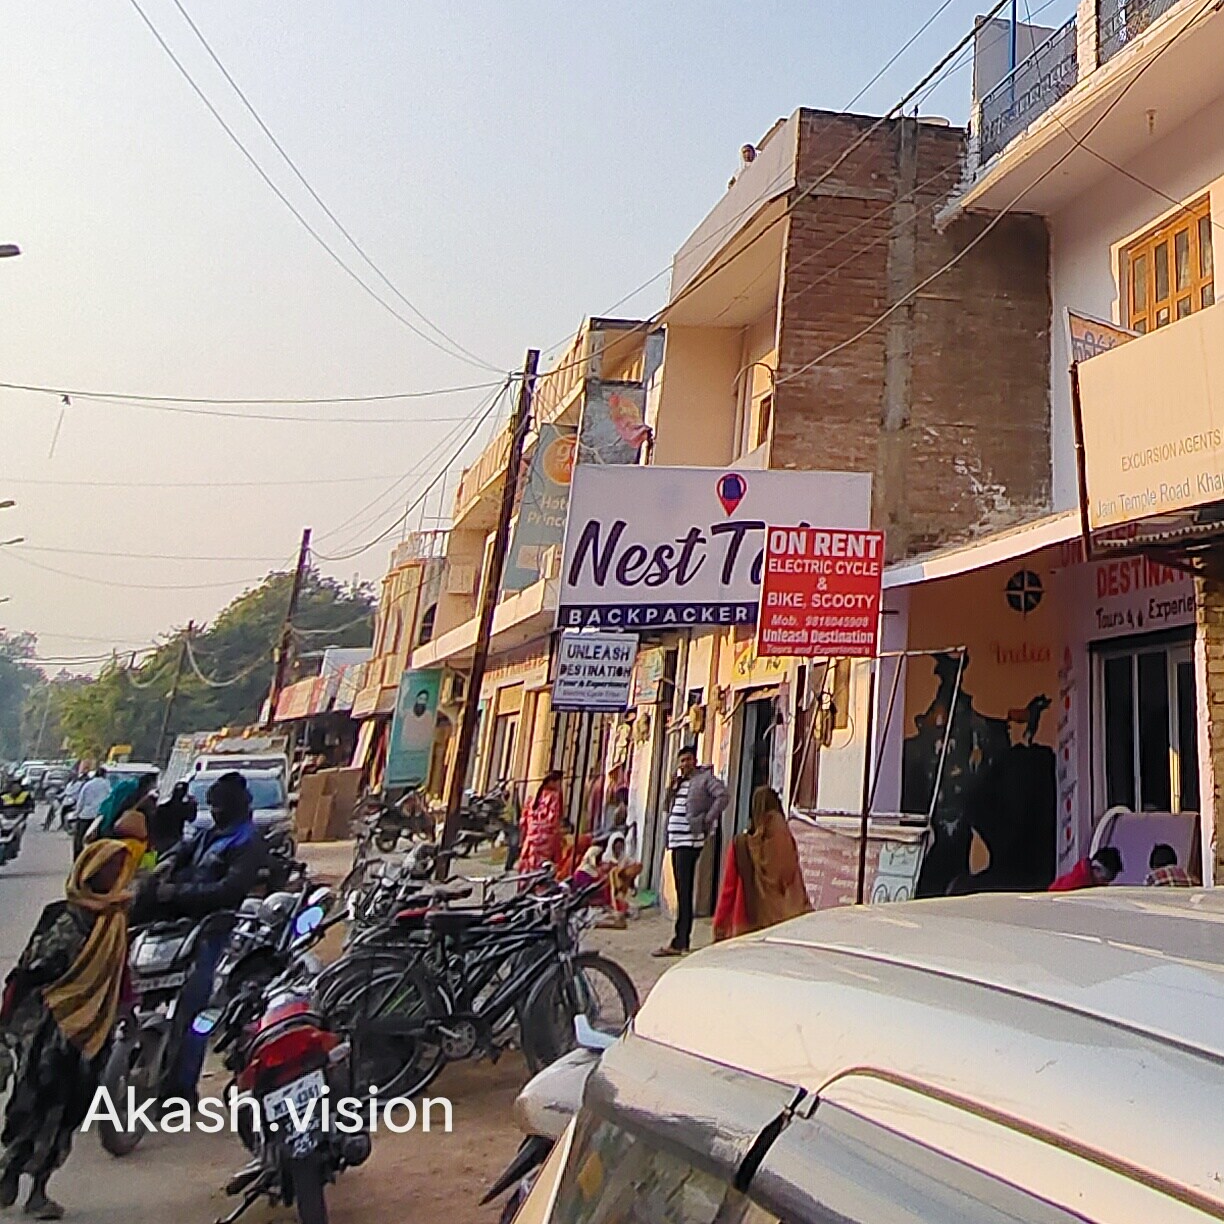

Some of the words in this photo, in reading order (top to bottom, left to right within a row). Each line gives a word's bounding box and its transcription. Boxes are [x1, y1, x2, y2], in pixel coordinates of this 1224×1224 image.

[1121, 443, 1177, 472] EXCURSION
[1178, 429, 1222, 456] AGENTS
[1118, 487, 1157, 513] Temple
[567, 520, 707, 587] Nest
[769, 530, 807, 555] ON
[813, 532, 881, 559] RENT
[768, 558, 833, 575] ELECTRIC
[835, 560, 879, 576] CYCLE
[816, 577, 828, 591] &
[767, 592, 807, 610] BIKE,
[811, 593, 875, 609] SCOOTY
[568, 607, 749, 625] BACKPACKER
[762, 628, 809, 643] Unleash
[810, 629, 874, 644] Destination
[567, 643, 631, 661] UNLEASH
[560, 663, 632, 677] DESTINATION
